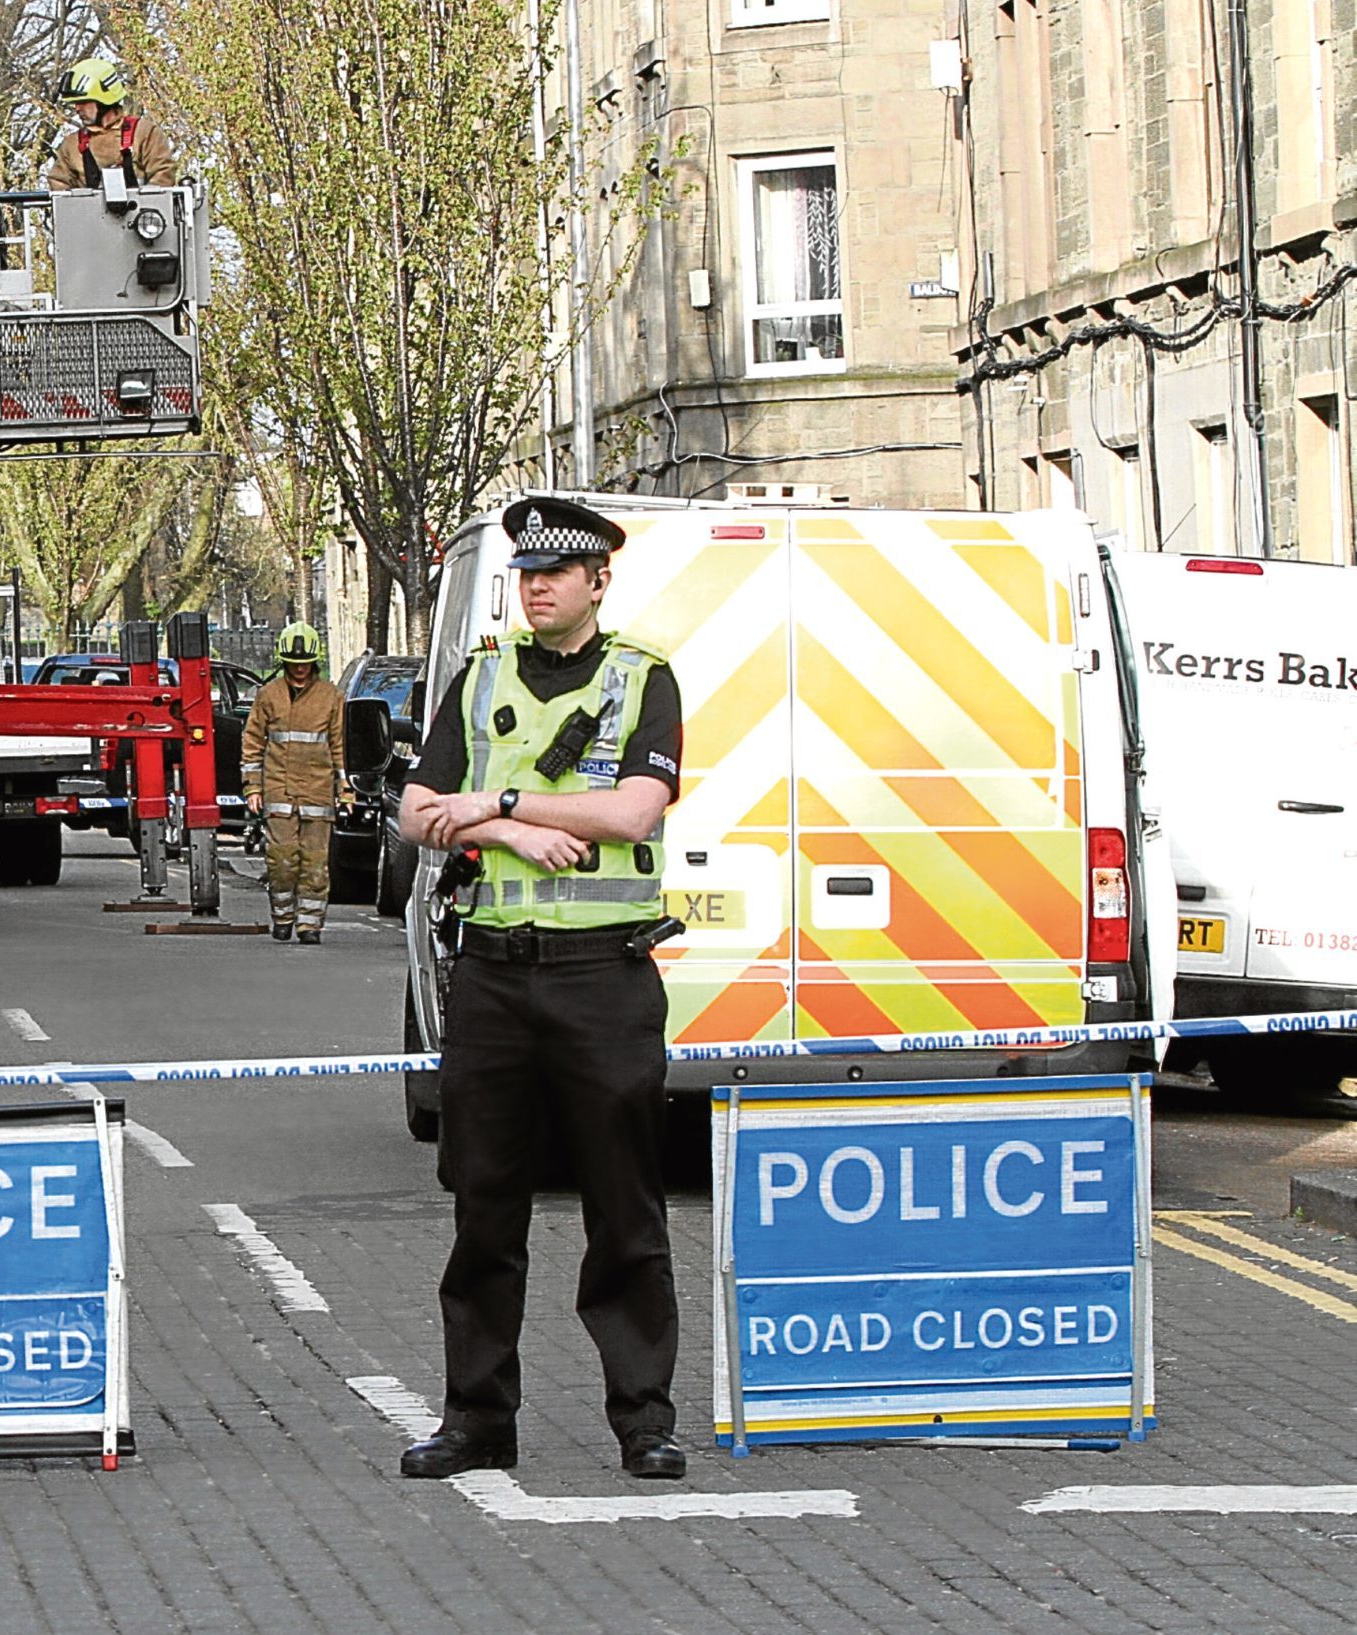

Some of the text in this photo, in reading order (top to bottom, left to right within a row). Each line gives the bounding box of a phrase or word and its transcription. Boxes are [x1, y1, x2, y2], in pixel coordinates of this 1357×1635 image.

[1143, 641, 1264, 683] Kerrs
[579, 761, 619, 776] POLIC
[663, 893, 725, 922] LXE
[1179, 919, 1213, 946] RT
[758, 1139, 1109, 1227] POLICE
[749, 1304, 1120, 1356] ROAD CLOSED
